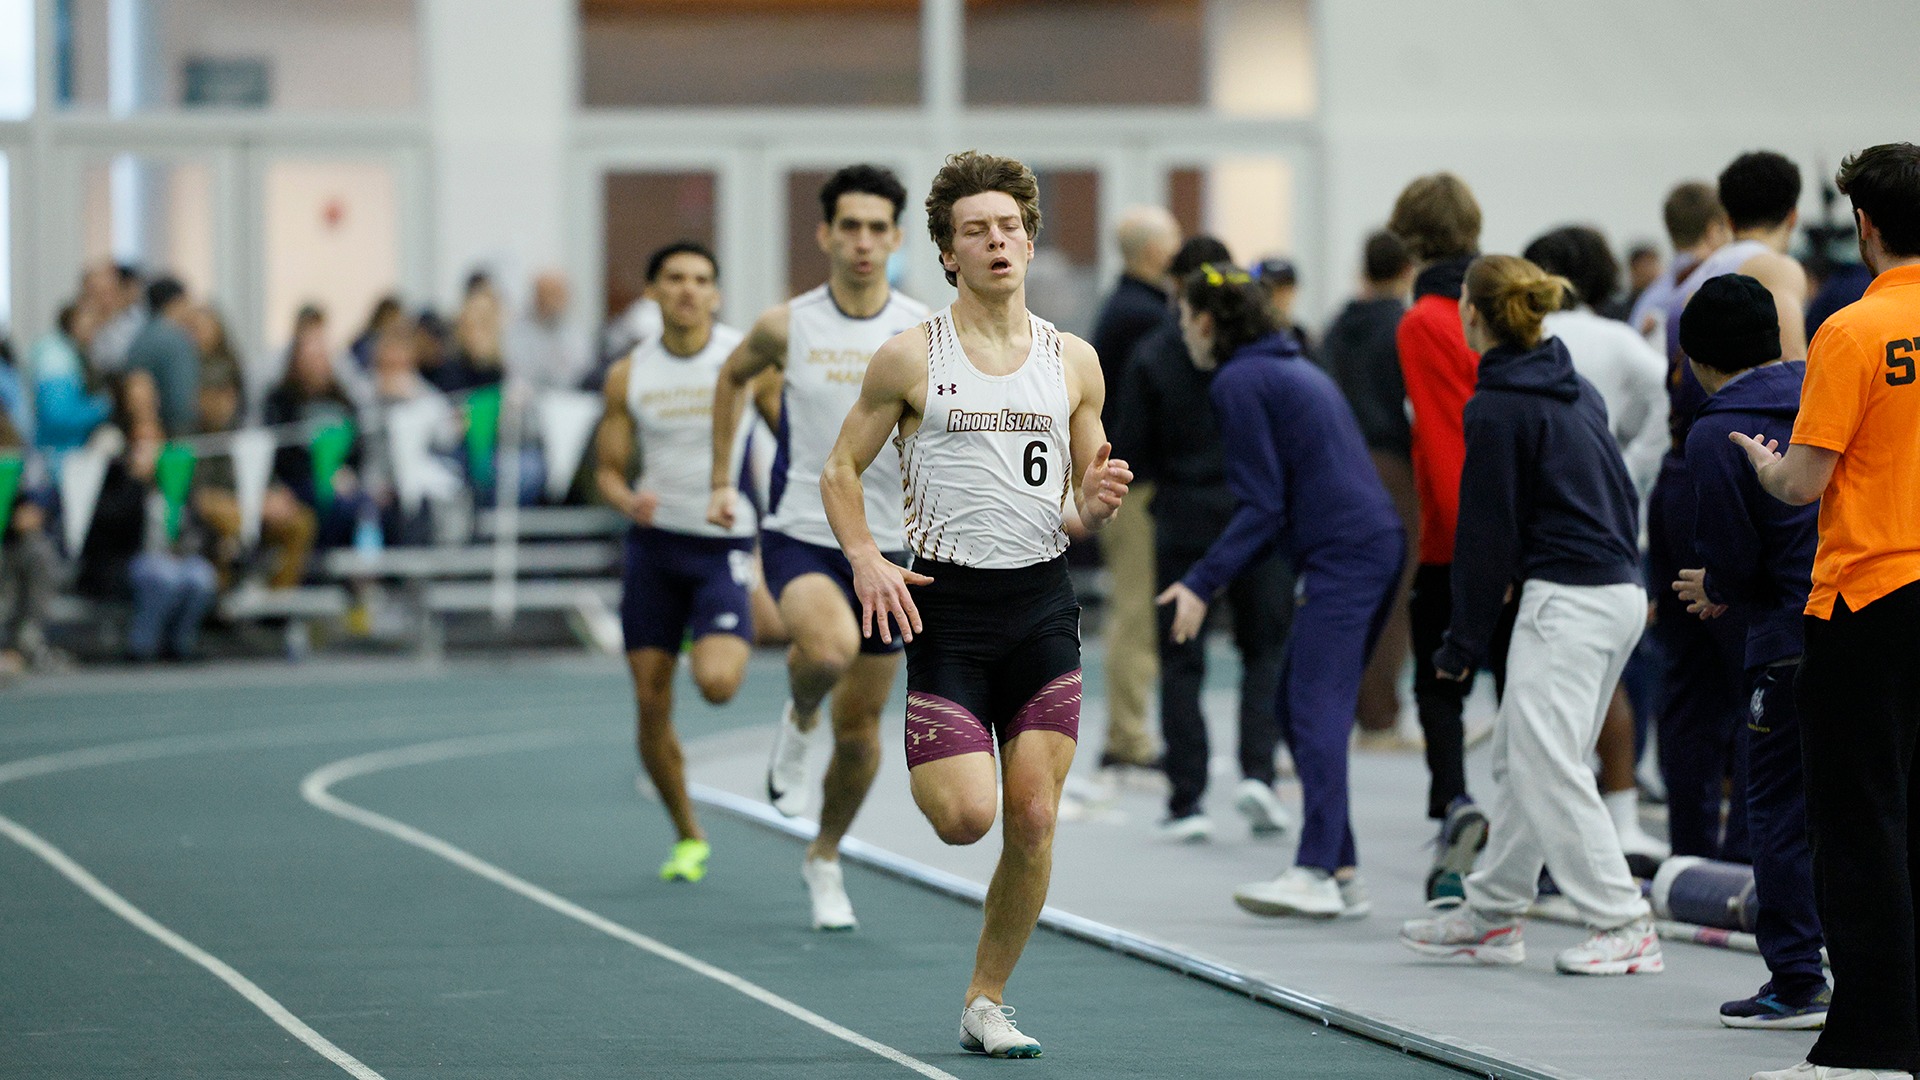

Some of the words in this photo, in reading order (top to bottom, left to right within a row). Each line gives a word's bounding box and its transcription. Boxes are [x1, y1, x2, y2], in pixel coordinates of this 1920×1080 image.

[1886, 337, 1920, 386] S
[947, 409, 998, 432] RHODE
[999, 409, 1052, 432] ISLAND
[1023, 440, 1048, 487] 6
